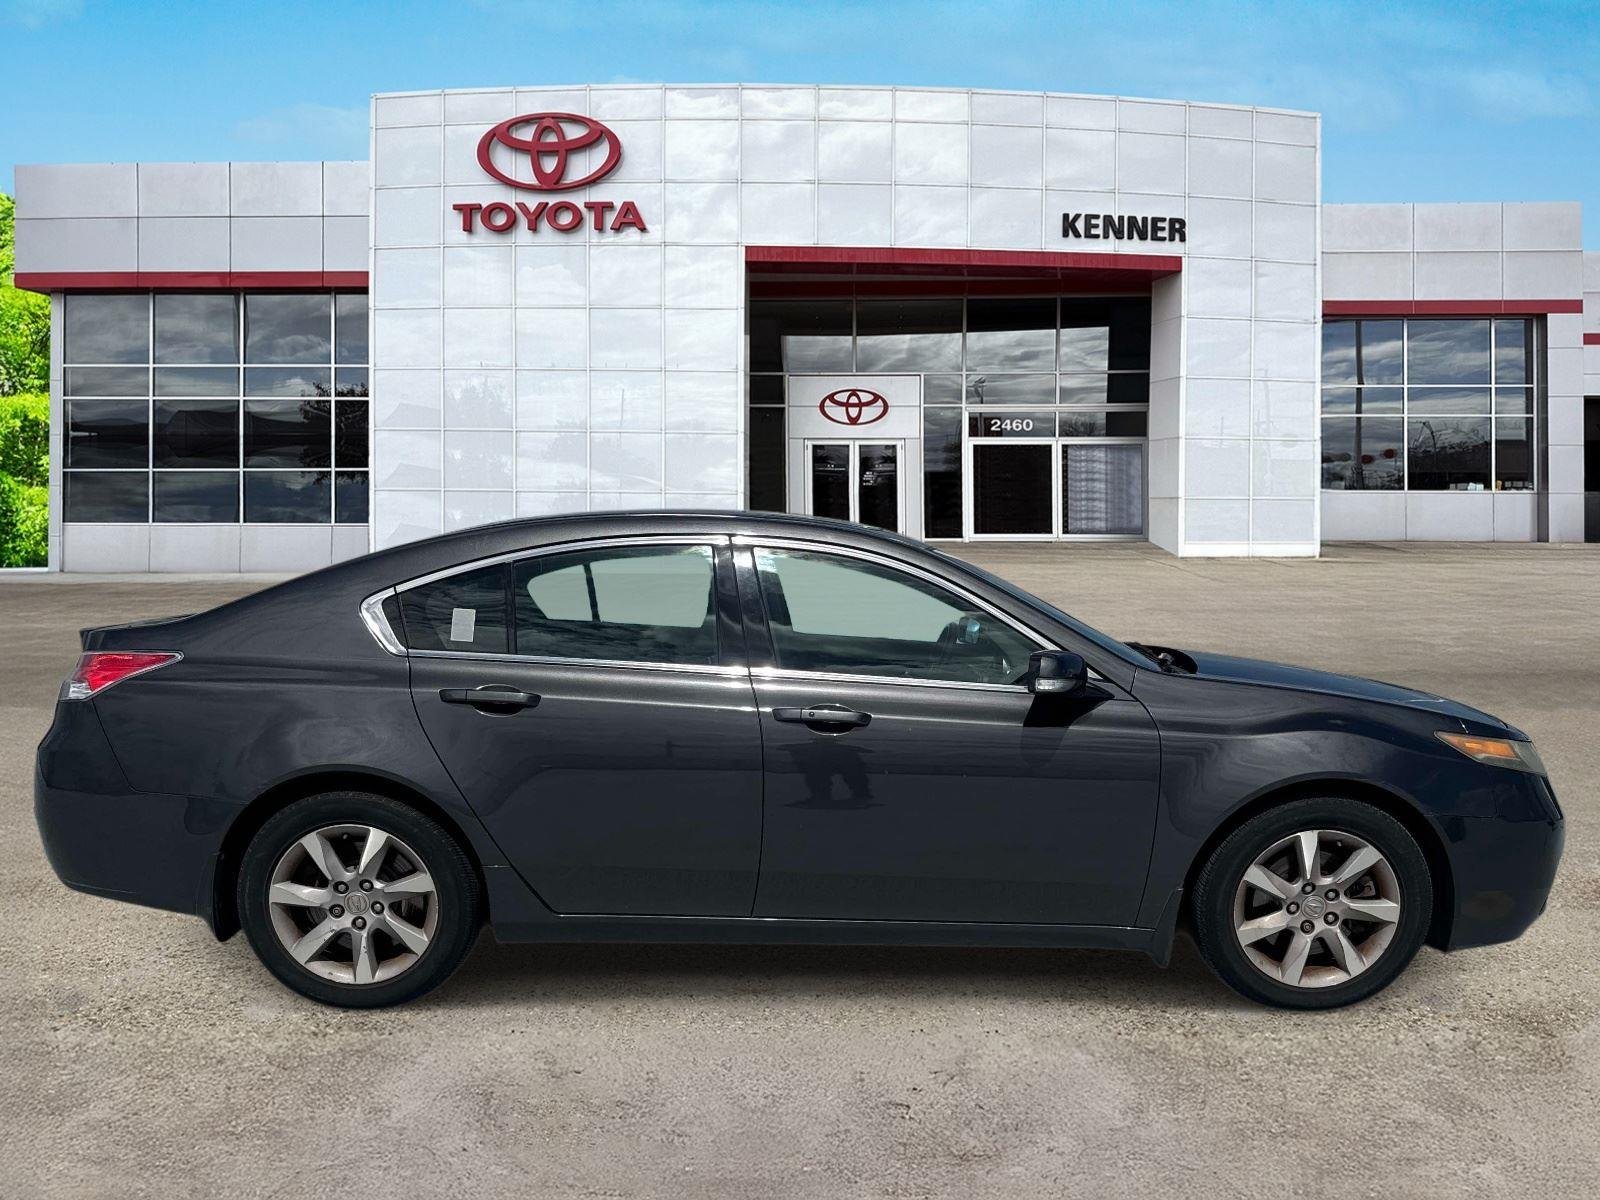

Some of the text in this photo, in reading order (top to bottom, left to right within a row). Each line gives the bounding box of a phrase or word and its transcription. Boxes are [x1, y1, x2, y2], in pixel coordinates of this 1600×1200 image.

[453, 201, 647, 232] TOYOTA
[1062, 213, 1186, 242] KENNER
[990, 419, 1033, 431] 2460
